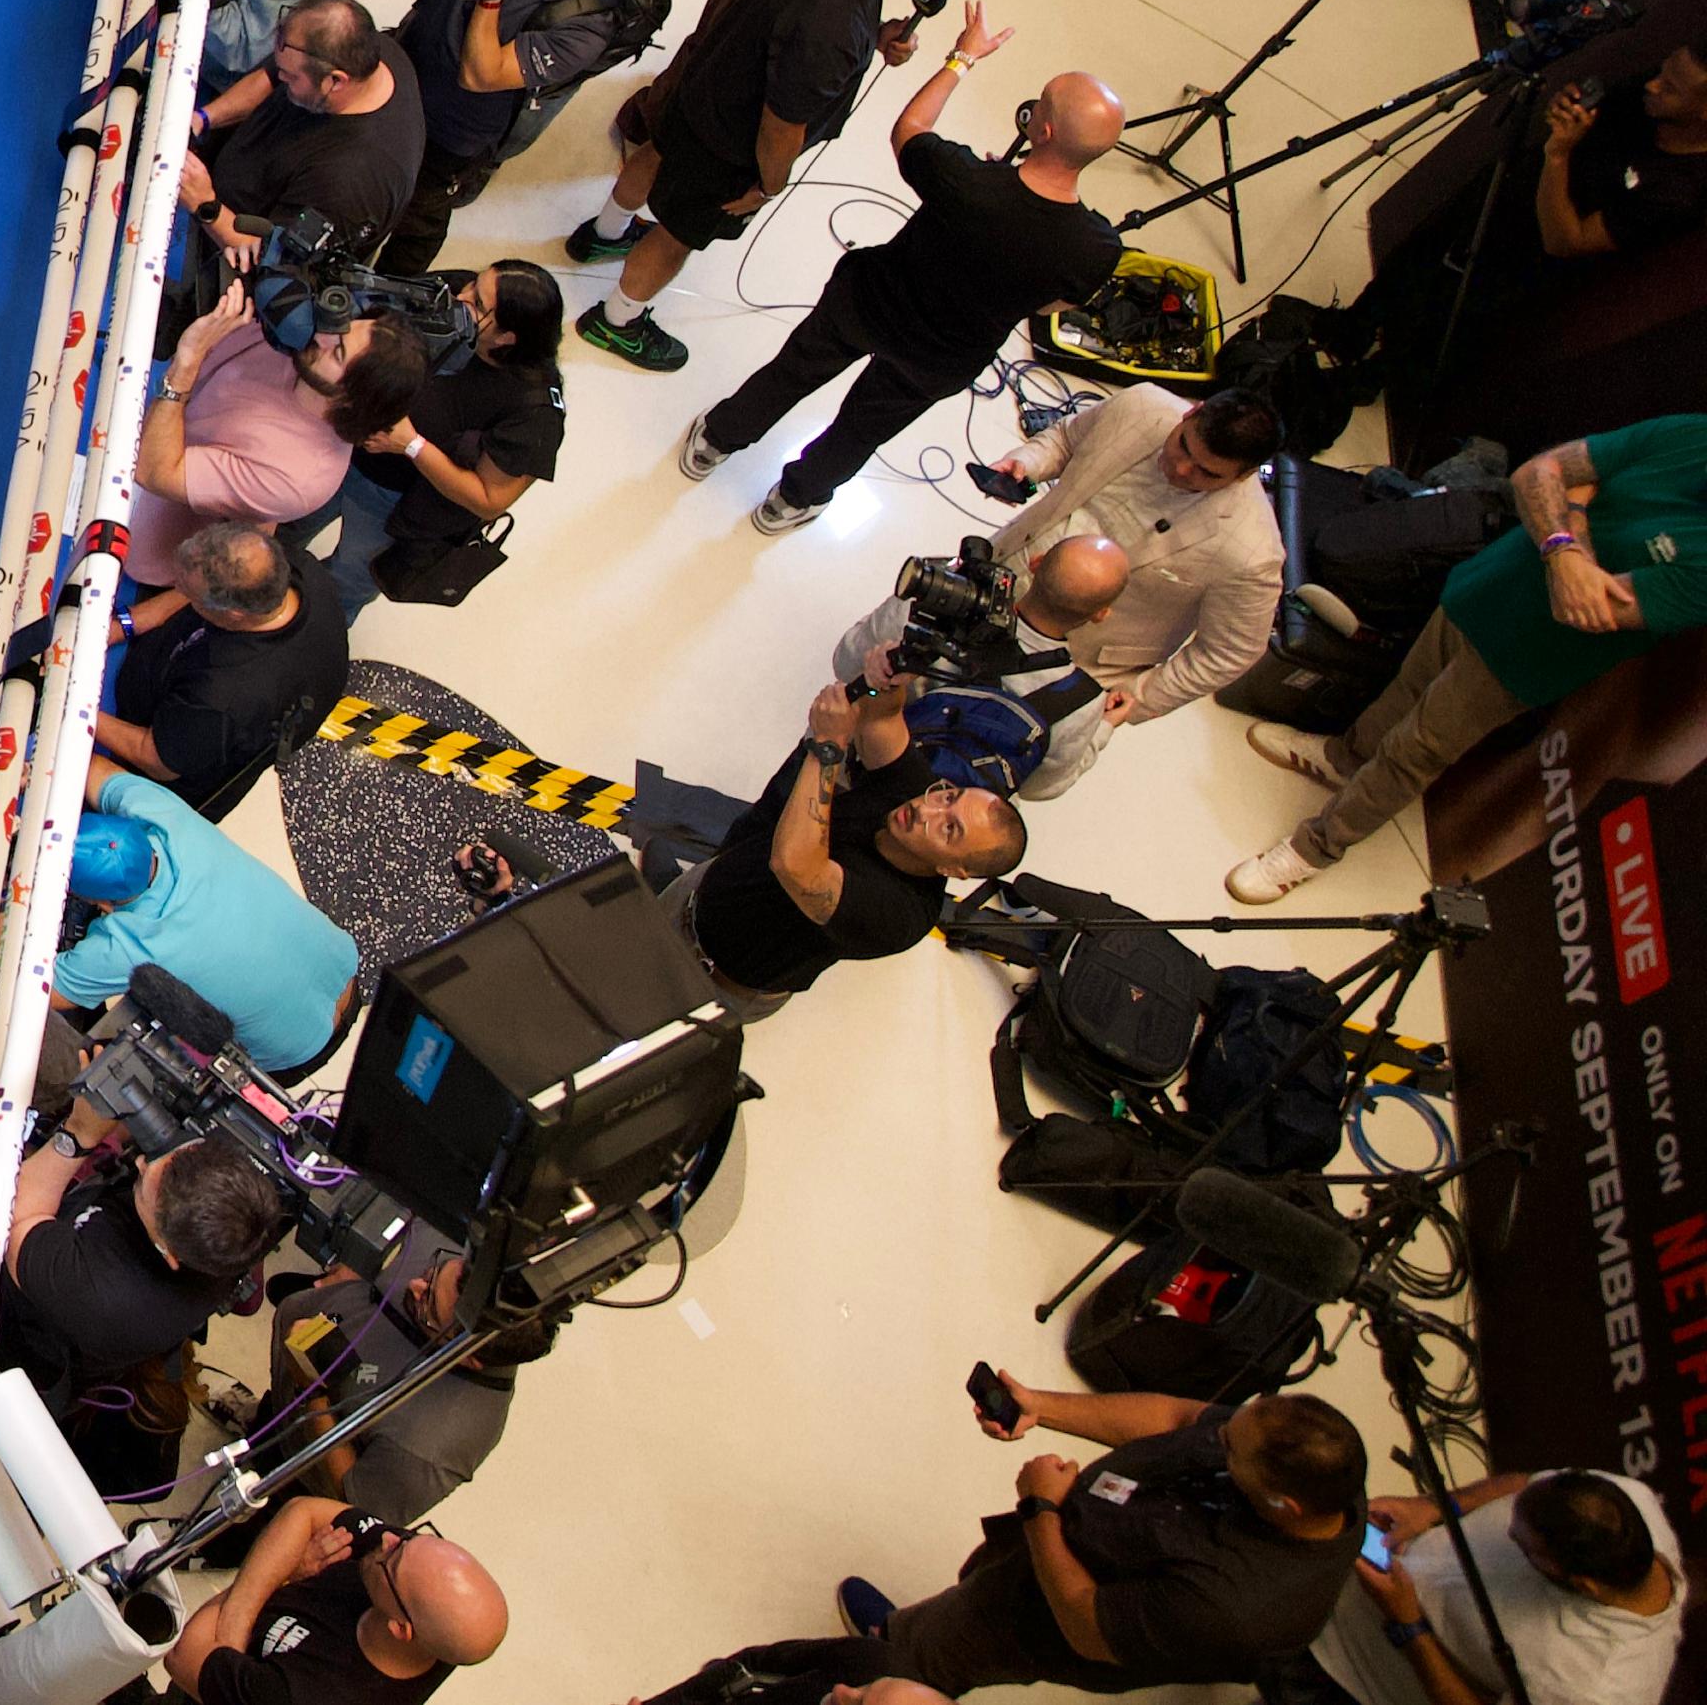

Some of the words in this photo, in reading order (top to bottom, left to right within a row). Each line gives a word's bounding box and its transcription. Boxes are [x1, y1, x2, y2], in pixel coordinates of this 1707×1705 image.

[1610, 853, 1659, 982] LIVE
[1538, 728, 1598, 1007] SATURDAY
[1569, 1019, 1646, 1393] SEPTEMBER
[1618, 1404, 1660, 1480] 13
[1640, 1024, 1678, 1128] ONLY
[1653, 1135, 1684, 1194] ON
